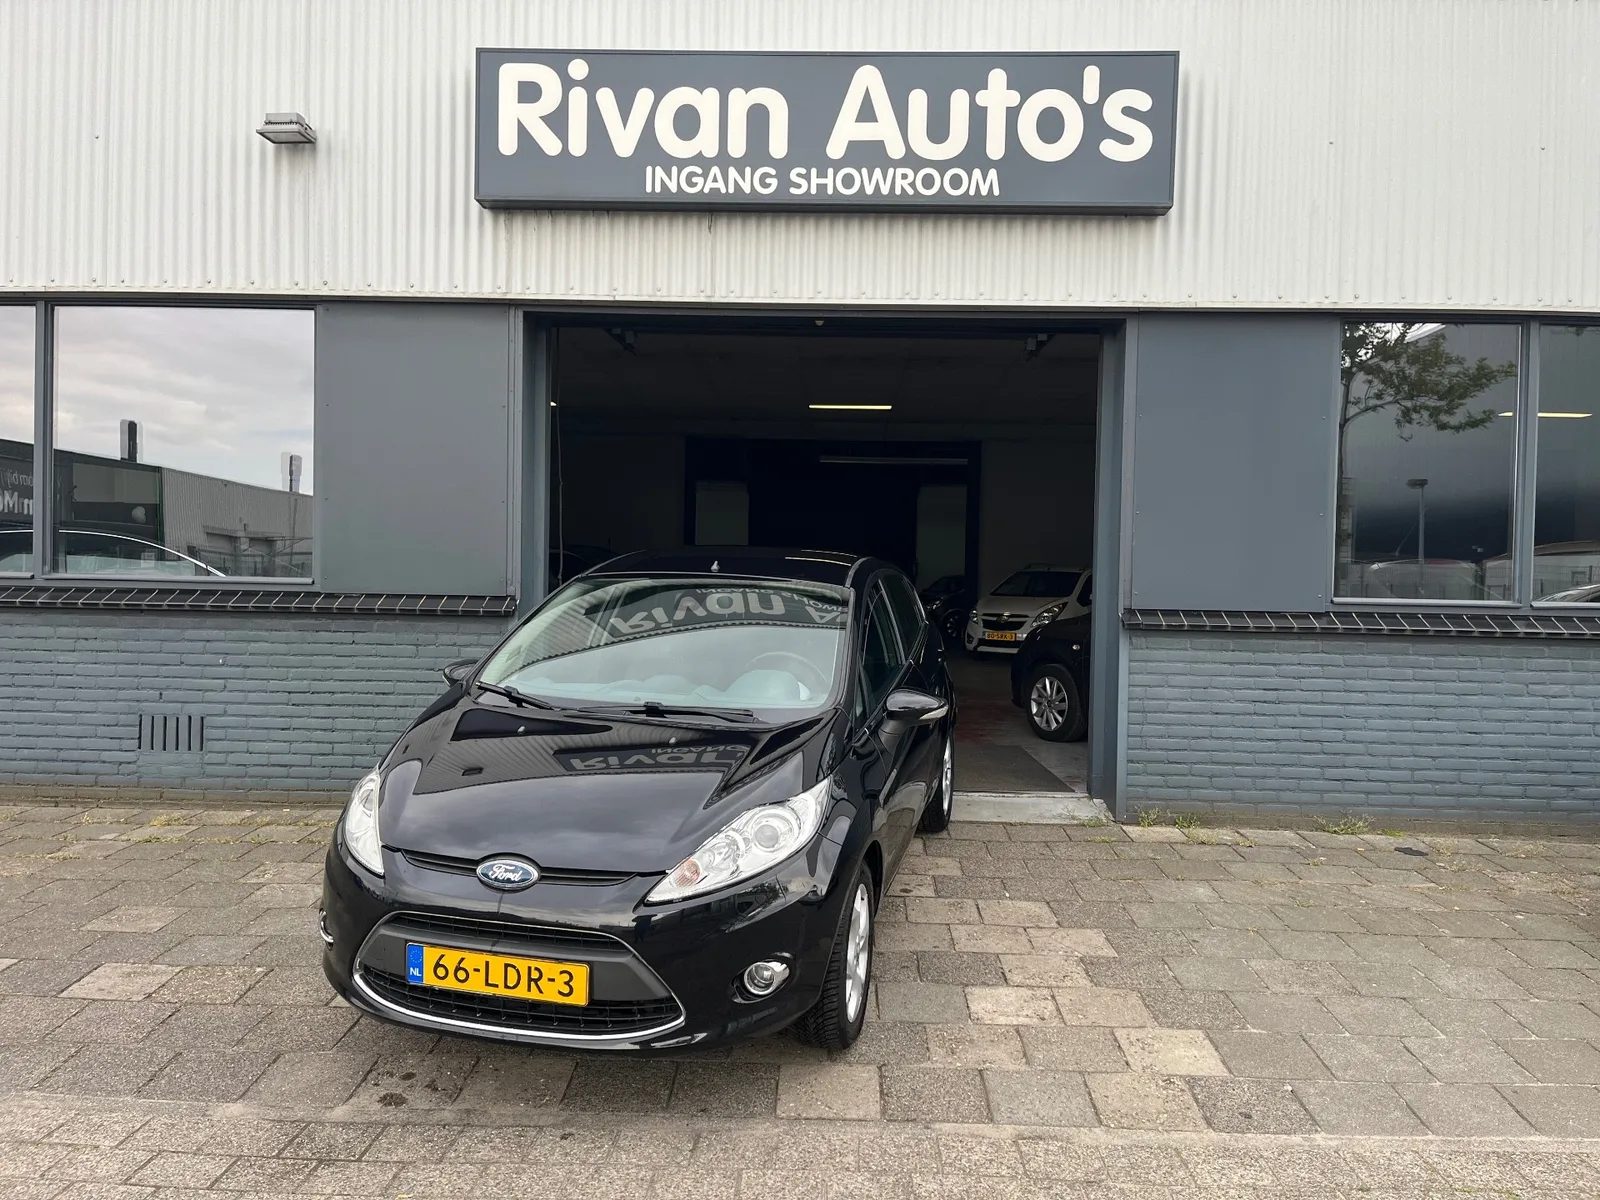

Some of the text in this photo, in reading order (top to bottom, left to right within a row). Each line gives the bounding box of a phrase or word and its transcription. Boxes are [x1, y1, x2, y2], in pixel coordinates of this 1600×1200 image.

[497, 58, 1153, 163] Rivan Auto's
[644, 165, 1001, 198] INGANG SHOWROOM
[489, 864, 523, 882] Ford
[410, 967, 422, 977] NL
[432, 954, 575, 998] 66-LDR-3
